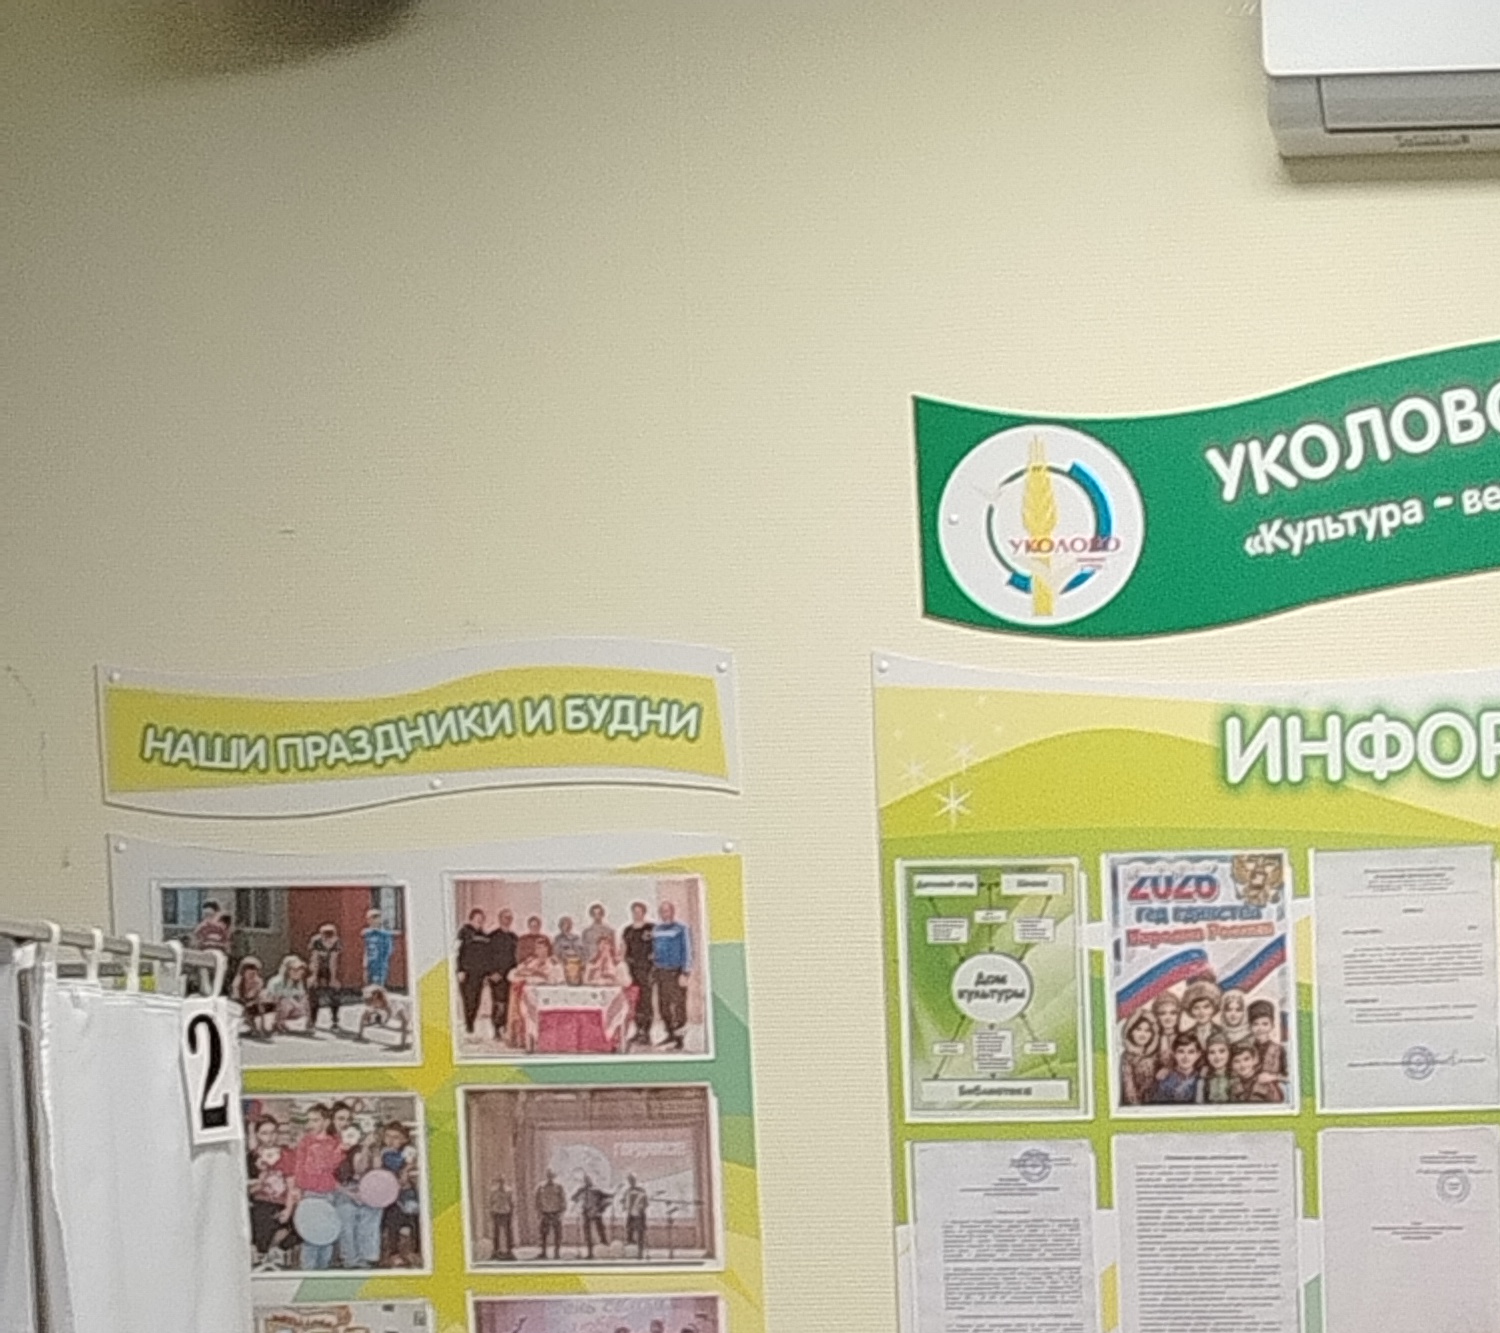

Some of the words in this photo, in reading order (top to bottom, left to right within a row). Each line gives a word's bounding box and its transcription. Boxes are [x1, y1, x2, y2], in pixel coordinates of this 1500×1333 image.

[1008, 534, 1121, 555] УКОЛОВО
[1244, 496, 1423, 558] «Культура
[142, 726, 268, 771] НАШИ
[276, 699, 514, 770] ПРАЗДНИКИ
[523, 696, 554, 735] И
[564, 694, 701, 740] БУДНИ
[974, 971, 1008, 987] Дом
[187, 1013, 231, 1131] 2
